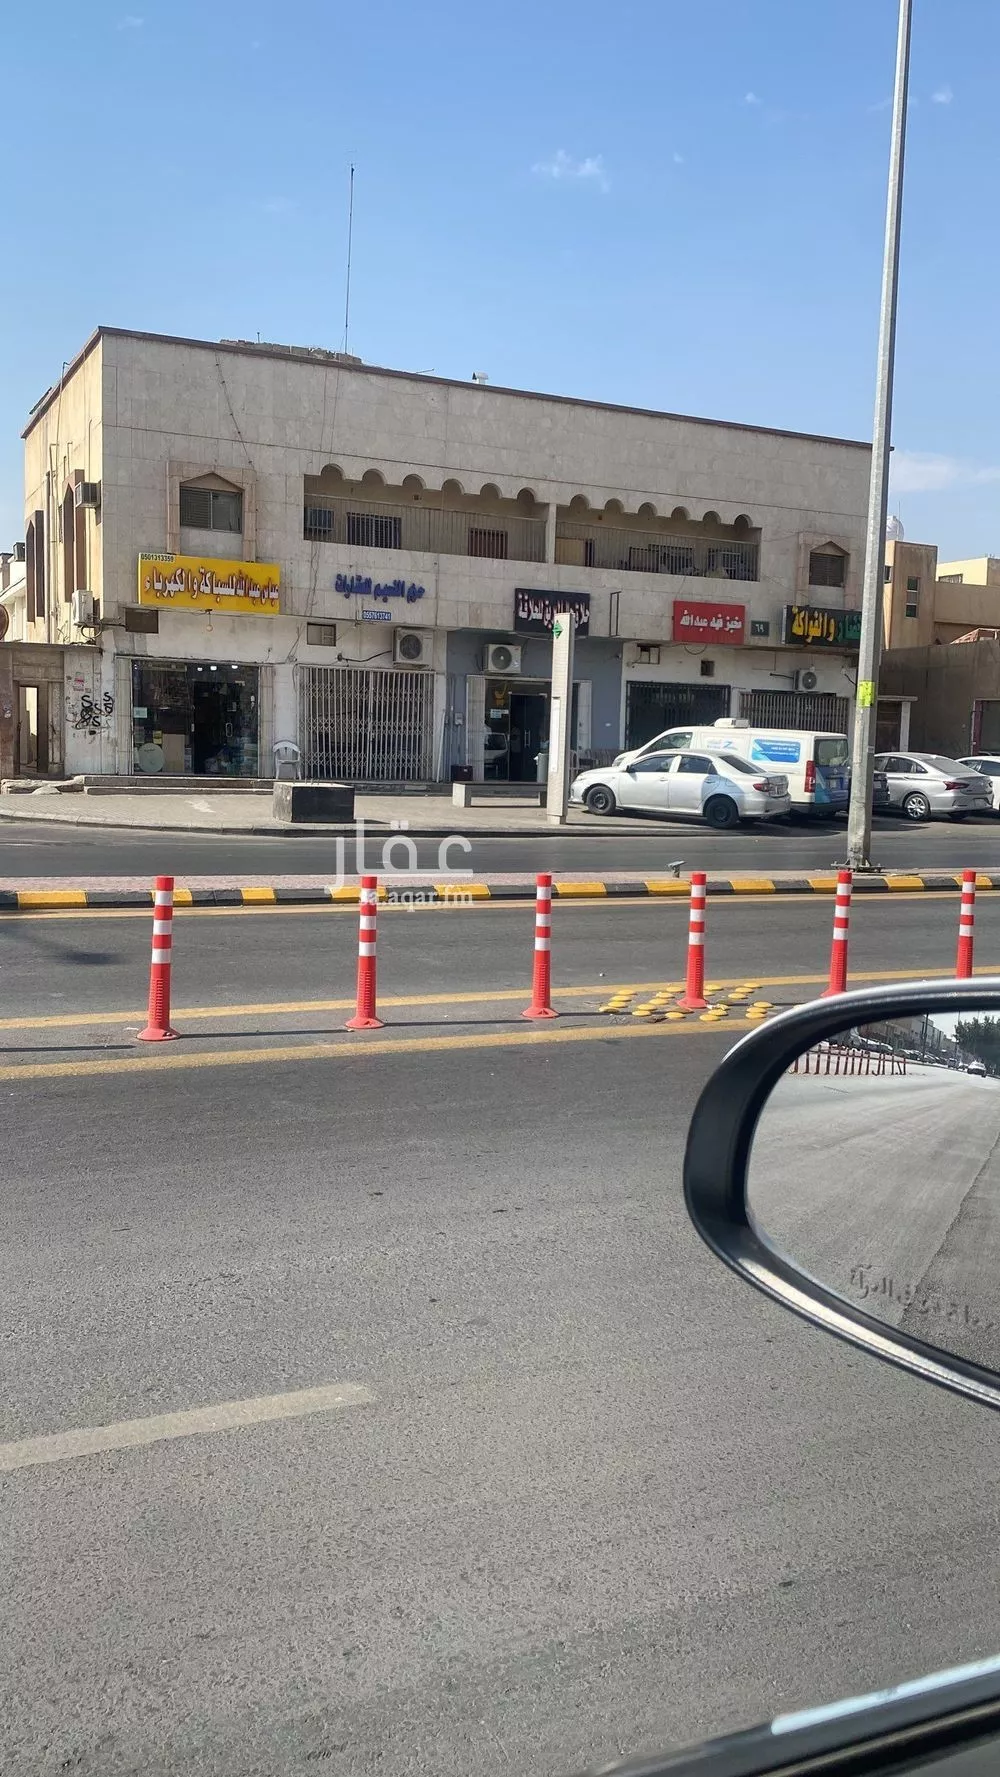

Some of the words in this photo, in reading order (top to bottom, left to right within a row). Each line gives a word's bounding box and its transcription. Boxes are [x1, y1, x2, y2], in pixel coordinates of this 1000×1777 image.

[199, 566, 235, 604] للسباكة
[335, 573, 371, 599] للعقارات
[374, 579, 405, 603] النسيم
[724, 616, 742, 633] مخبز
